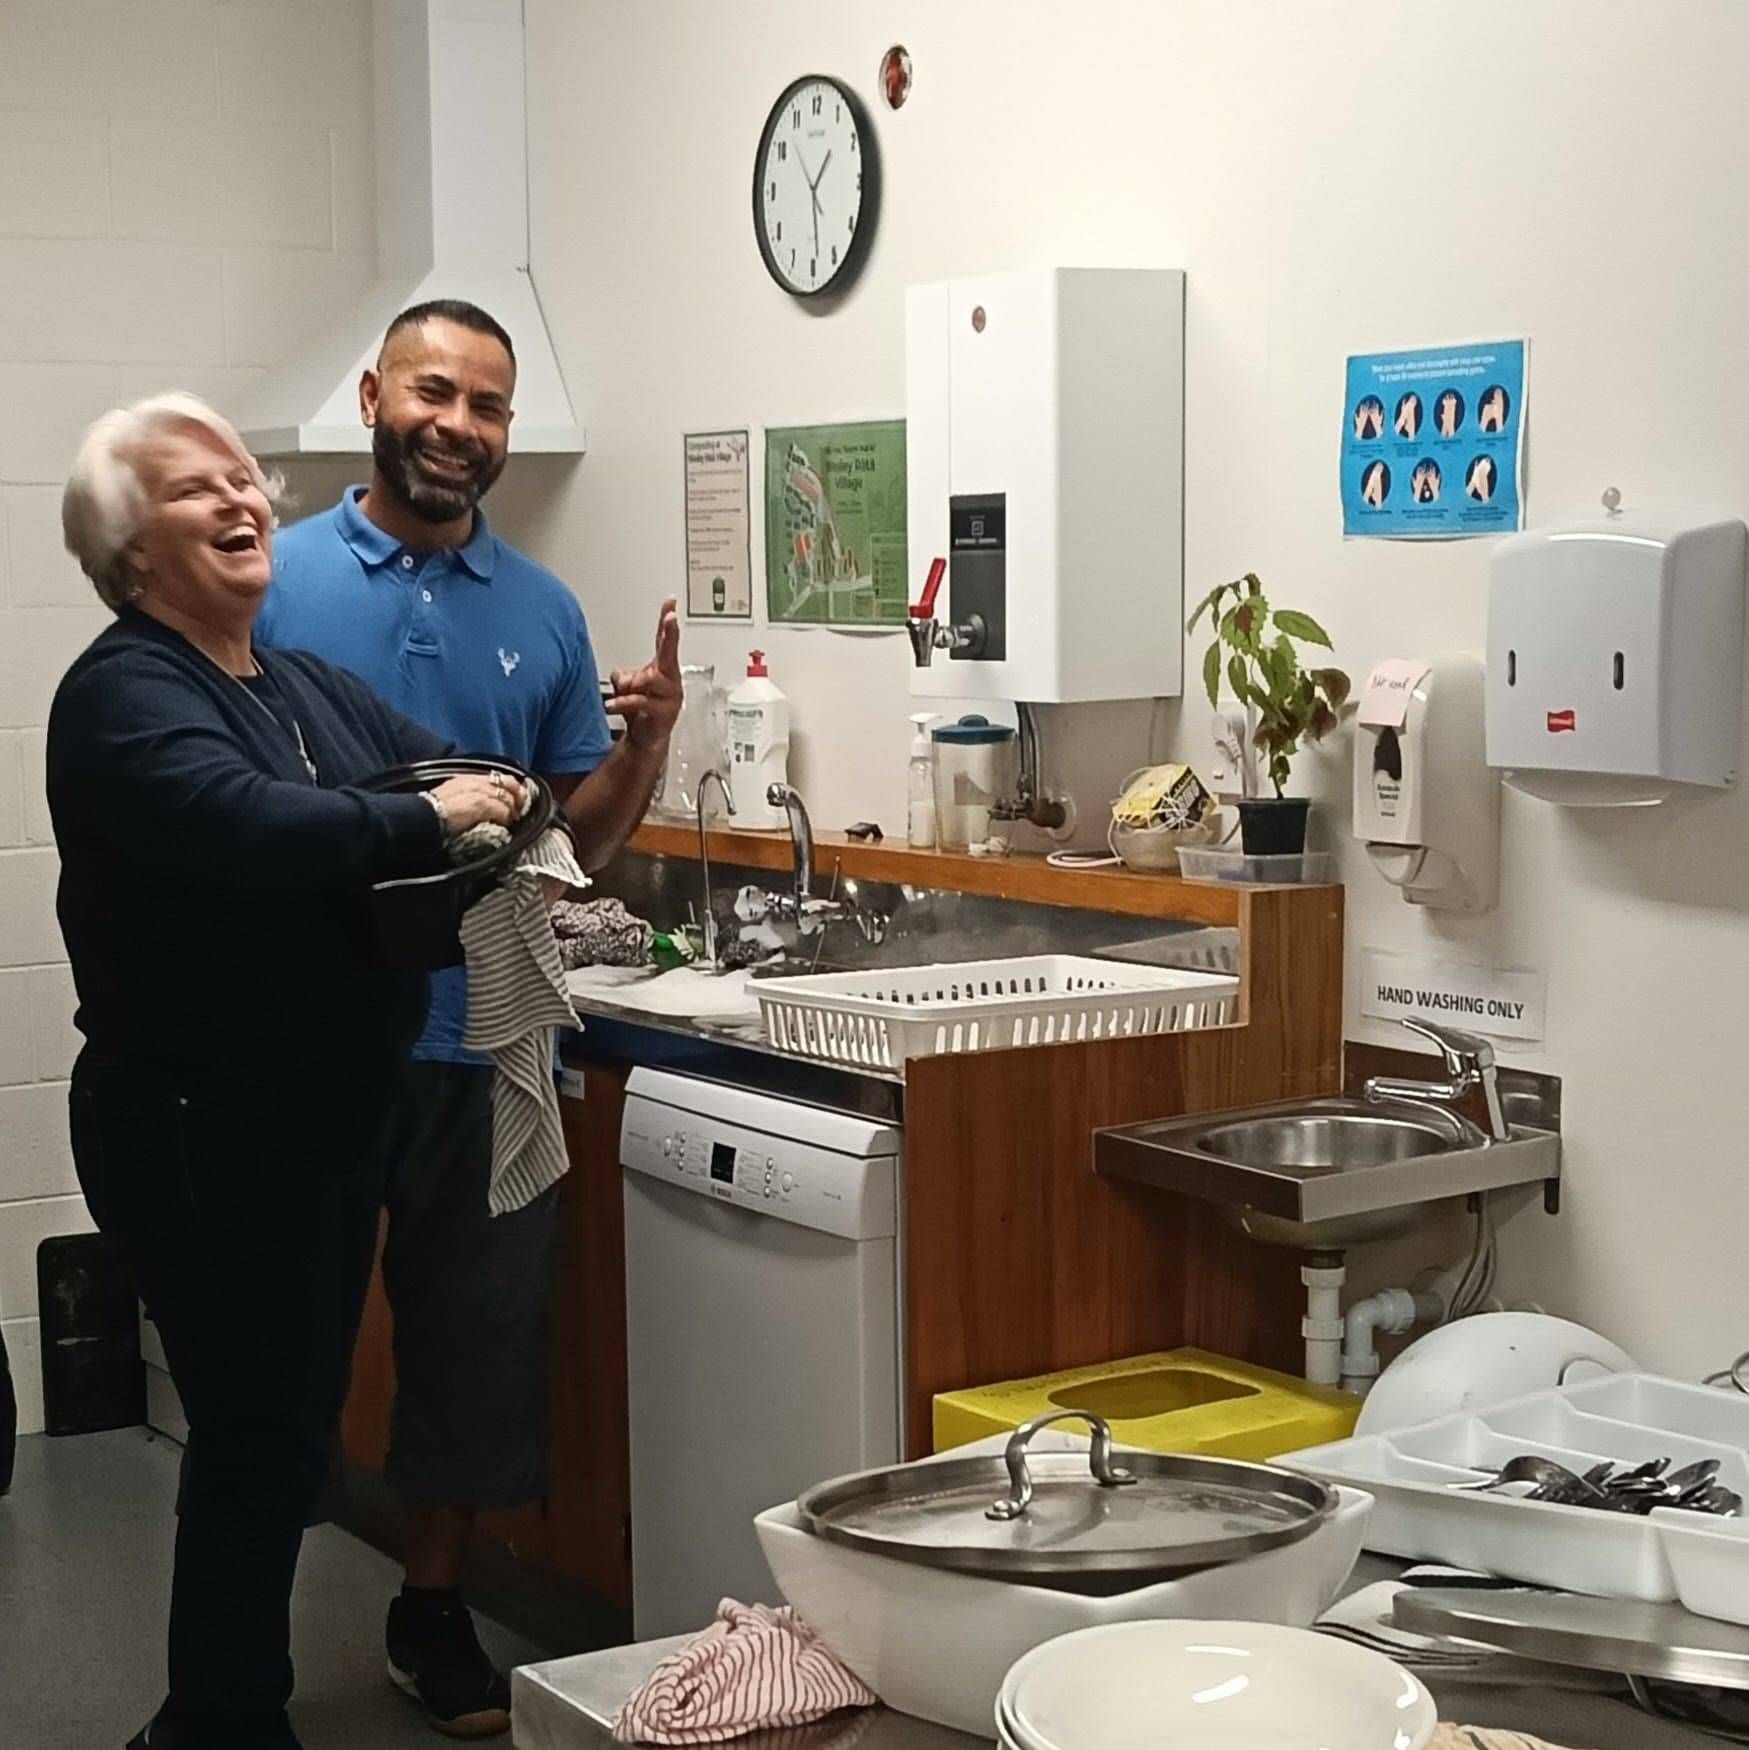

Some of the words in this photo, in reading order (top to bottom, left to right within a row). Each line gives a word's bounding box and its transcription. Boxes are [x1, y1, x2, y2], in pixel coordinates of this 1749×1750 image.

[813, 95, 822, 115] 12
[793, 110, 800, 129] 11
[778, 141, 786, 161] 10
[851, 132, 856, 152] 2
[1376, 984, 1414, 1005] HAND
[1416, 990, 1484, 1015] WASHING
[1486, 999, 1525, 1020] ONLY
